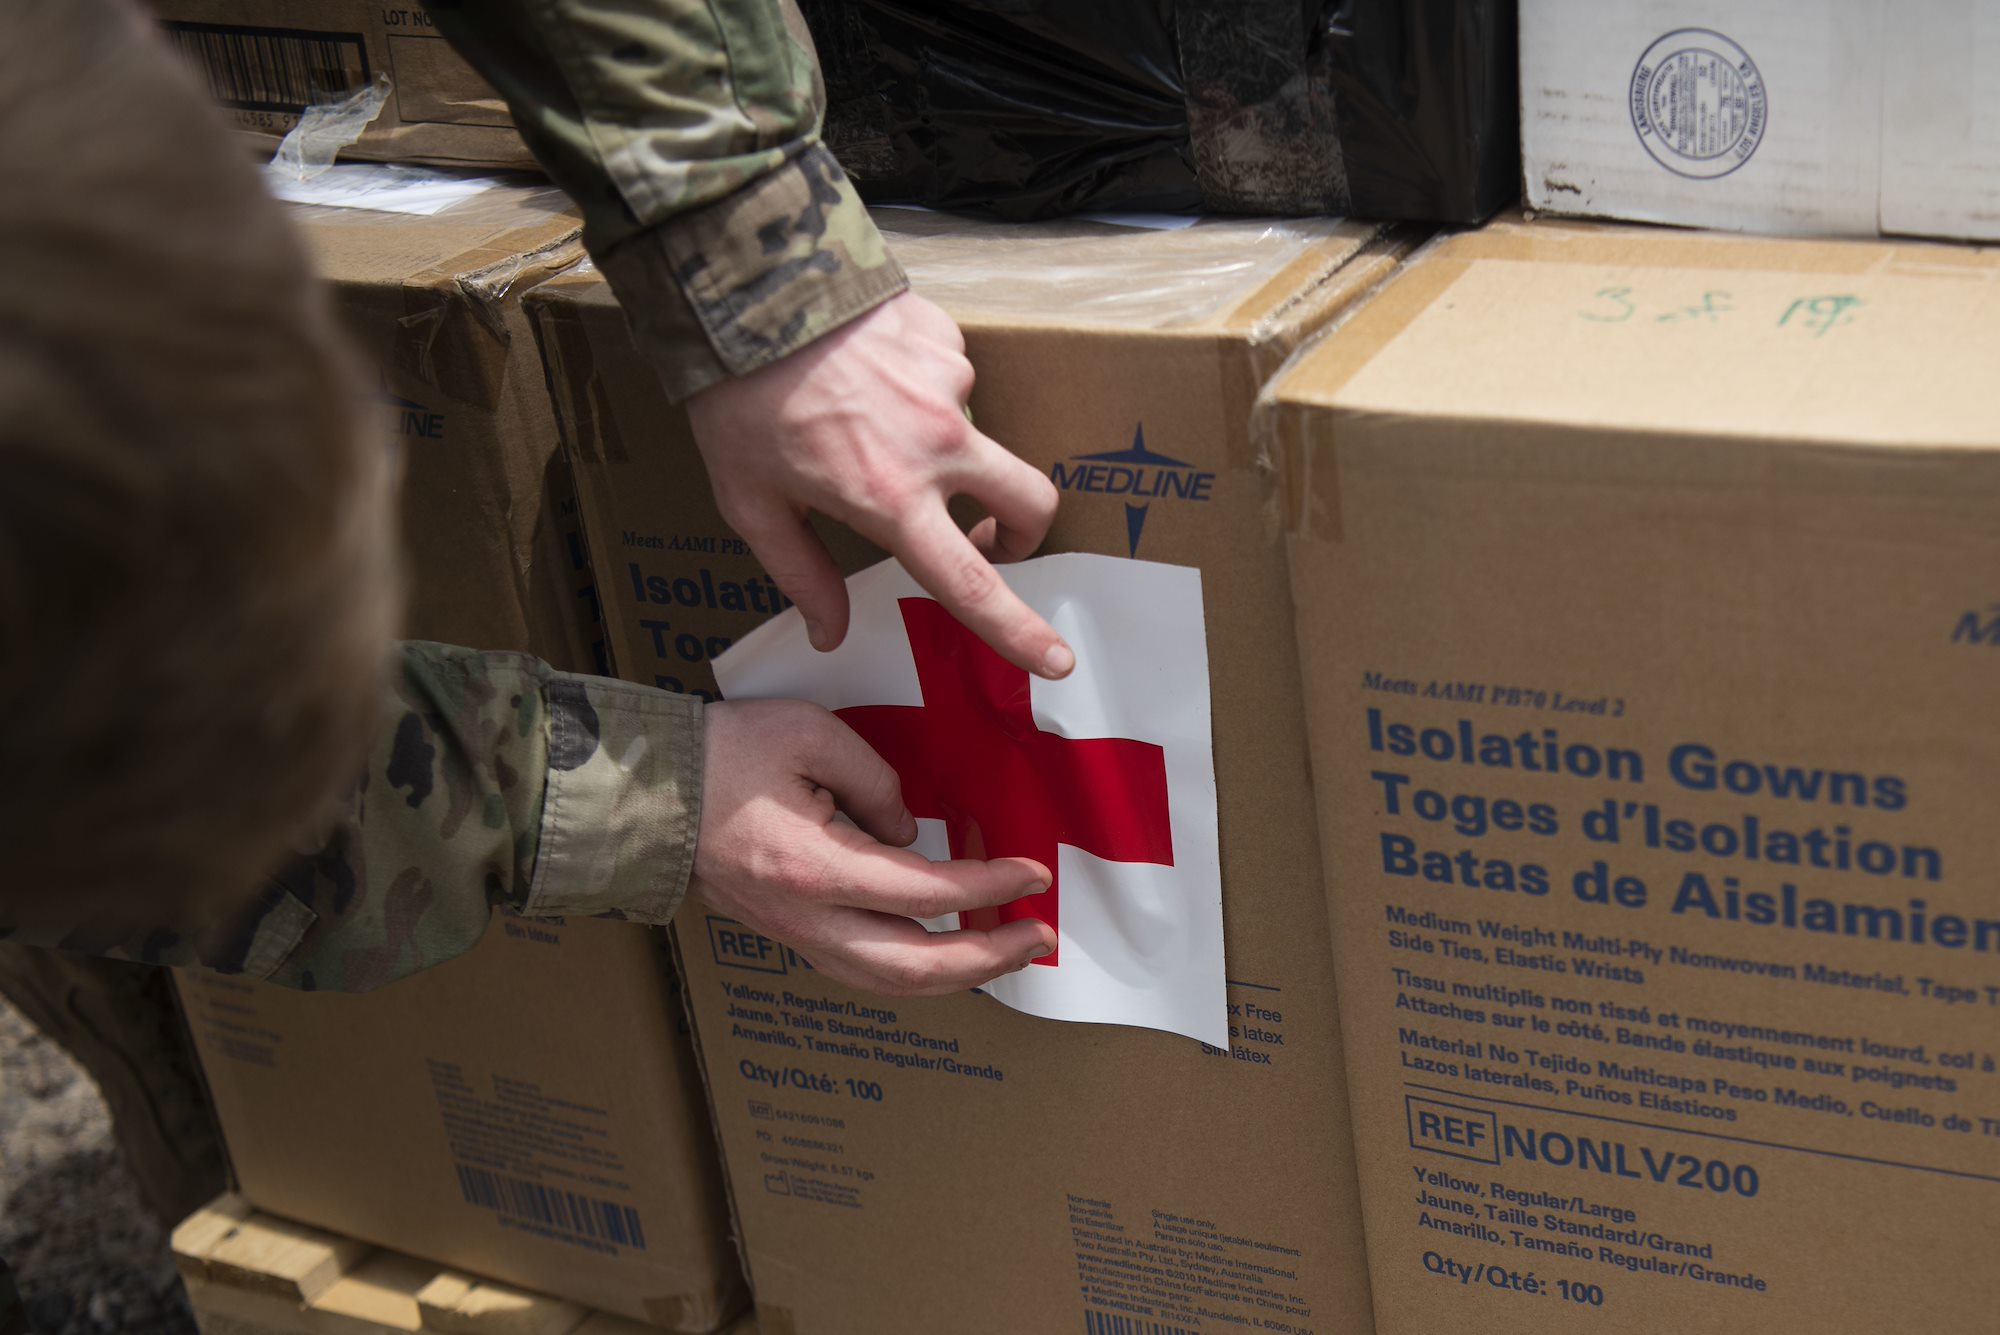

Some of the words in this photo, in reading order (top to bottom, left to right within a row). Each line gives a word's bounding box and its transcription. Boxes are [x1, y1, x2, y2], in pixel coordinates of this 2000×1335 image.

[382, 9, 407, 25] LOT
[1051, 462, 1216, 500] MEDLINE
[621, 531, 664, 549] Meets
[667, 536, 718, 552] AAMI
[628, 562, 795, 615] Isolati
[1363, 671, 1417, 697] Meets
[1422, 679, 1486, 703] AAMI
[1490, 686, 1546, 710] PB70
[1552, 691, 1607, 716] Level
[1611, 698, 1626, 717] 2
[1366, 707, 1644, 783] Isolation
[1668, 742, 1909, 811] Gowns
[1370, 769, 1559, 838] Toges
[1581, 798, 1943, 882] d’Isolation
[1379, 831, 1551, 898] Batas
[1572, 860, 1649, 909] de
[718, 929, 773, 960] REF
[1386, 905, 1471, 936] Medium
[1477, 919, 1557, 948] Weight
[1563, 931, 1663, 966] Multi-Ply
[1670, 946, 1797, 980] Nonwoven
[1803, 963, 1910, 997] Material,
[1915, 977, 1978, 1005] Tape
[1388, 930, 1434, 954] Side
[1439, 938, 1489, 965] Ties,
[1495, 947, 1567, 974] Elastic
[1572, 956, 1645, 985] Wrists
[721, 981, 781, 1008] Yellow,
[783, 990, 898, 1024] Regular/Large
[726, 1003, 779, 1028] Jaune,
[780, 1011, 824, 1034] Taille
[827, 1019, 960, 1054] Standard/Grand
[1244, 1003, 1283, 1022] Free
[1392, 967, 1446, 994] Tissu
[1452, 980, 1546, 1009] multiplis
[1551, 995, 1593, 1016] non
[1599, 1000, 1651, 1025] tissé
[1657, 1009, 1680, 1029] et
[1686, 1014, 1855, 1053] moyennement
[1861, 1036, 1931, 1066] lourd,
[1937, 1049, 1975, 1070] col
[1980, 1052, 1997, 1073] à
[732, 1024, 801, 1051] Amarillo,
[803, 1035, 870, 1061] Tamaño
[873, 1047, 1004, 1082] Regular/Grande
[1231, 1045, 1272, 1064] látex
[1243, 1025, 1284, 1045] latex
[1395, 992, 1487, 1024] Attaches
[1491, 1010, 1526, 1030] sur
[1531, 1014, 1551, 1034] le
[1556, 1019, 1610, 1045] côté,
[1616, 1027, 1687, 1055] Bande
[1692, 1038, 1797, 1070] élastique
[1803, 1057, 1846, 1078] aux
[1851, 1063, 1958, 1094] poignets
[739, 1058, 839, 1097] Qty/Qté:
[845, 1078, 883, 1102] 100
[1399, 1027, 1483, 1060] Material
[1488, 1043, 1521, 1066] No
[1523, 1050, 1592, 1078] Tejido
[1597, 1060, 1707, 1095] Multicapa
[1713, 1077, 1768, 1103] Peso
[1774, 1087, 1854, 1118] Medio,
[1860, 1100, 1936, 1129] Cuello
[1942, 1113, 1972, 1134] de
[1401, 1050, 1460, 1078] Lazos
[1464, 1063, 1561, 1097] laterales,
[1565, 1078, 1633, 1107] Puños
[1638, 1093, 1738, 1123] Elásticos
[1417, 1110, 1486, 1149] REF
[1502, 1123, 1761, 1199] NONLV200
[1151, 1209, 1178, 1222] Single
[1179, 1216, 1195, 1226] use
[1411, 1165, 1486, 1199] Yellow,
[1490, 1181, 1637, 1226] Regular/Large
[1154, 1230, 1174, 1242] Para
[1161, 1223, 1187, 1235] usage
[1188, 1227, 1218, 1242] unique
[1415, 1189, 1481, 1221] Jaune,
[1484, 1201, 1539, 1230] Taille
[1543, 1213, 1713, 1262] Standard/Grand
[1417, 1210, 1508, 1249] Amarillo,
[1510, 1228, 1594, 1261] Tamaño
[1598, 1245, 1768, 1293] Regular/Grande
[1072, 1227, 1123, 1245] Distributed
[1124, 1237, 1134, 1247] in
[1135, 1239, 1177, 1255] Australia
[1195, 1251, 1233, 1267] Medline
[1235, 1259, 1299, 1281] International,
[1076, 1252, 1164, 1275] www.medline.com
[1198, 1276, 1236, 1290] Medline
[1238, 1283, 1287, 1302] Industries,
[1289, 1294, 1306, 1305] Inc.
[1096, 1242, 1137, 1258] Australia
[1220, 1267, 1264, 1284] Australia
[1422, 1250, 1548, 1298] Qty/Qté:
[1556, 1278, 1605, 1308] 100
[1078, 1262, 1141, 1282] Manufactured
[1256, 1297, 1284, 1311] Chine
